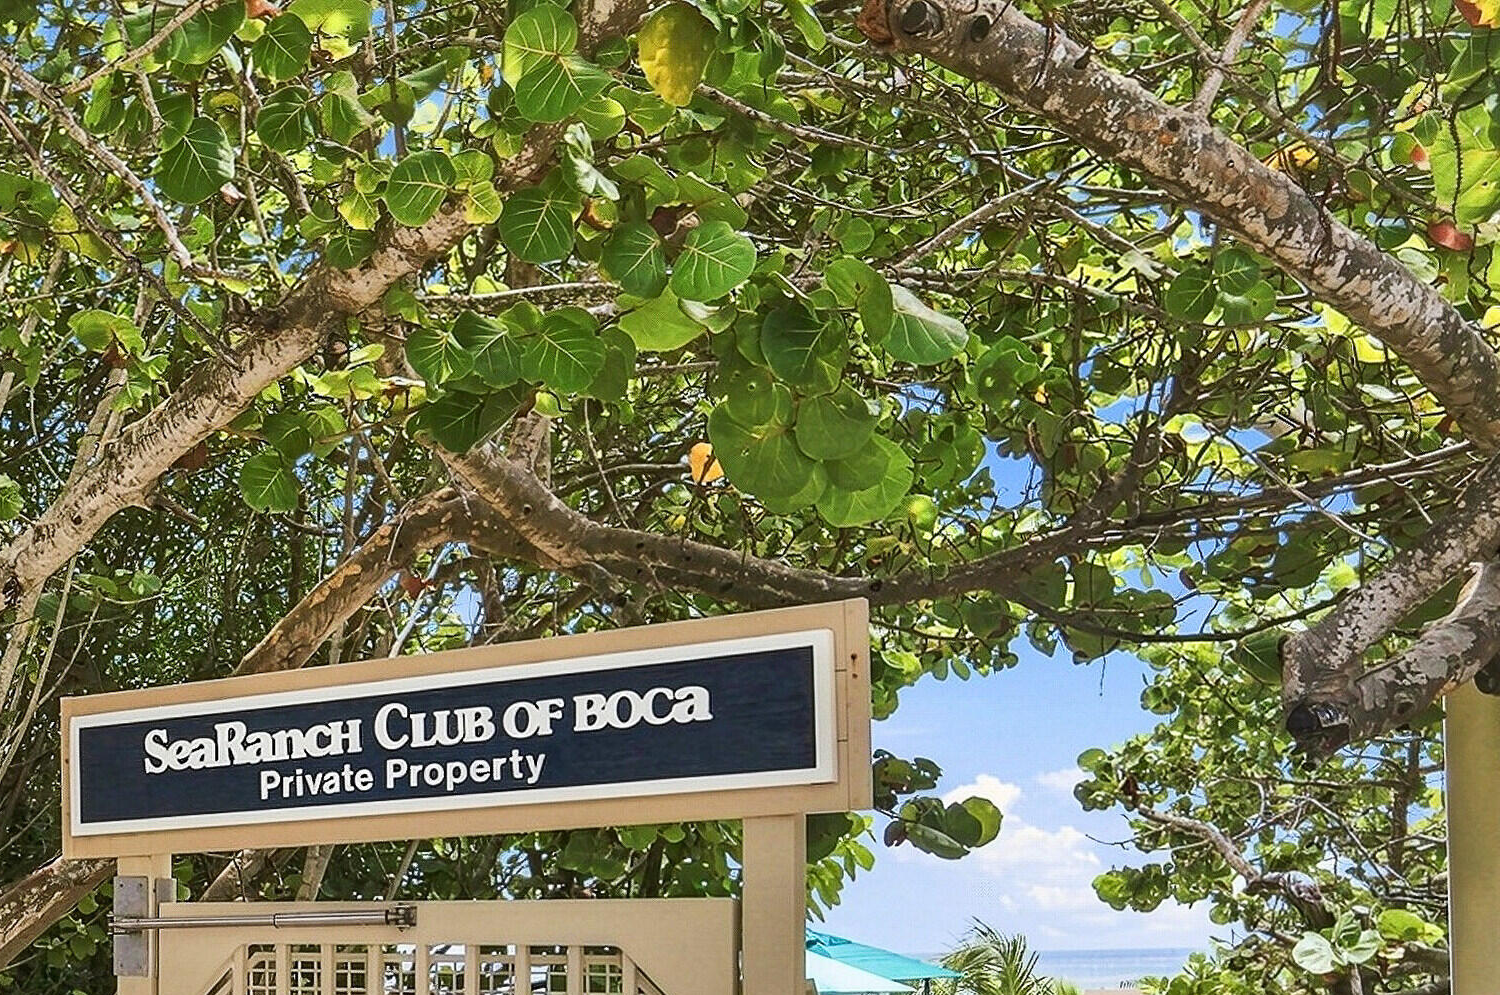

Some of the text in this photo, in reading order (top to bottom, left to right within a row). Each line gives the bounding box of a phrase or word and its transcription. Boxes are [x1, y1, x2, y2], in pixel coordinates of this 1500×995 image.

[373, 702, 496, 750] CLUB
[502, 698, 565, 739] OF
[260, 749, 547, 801] Private Property
